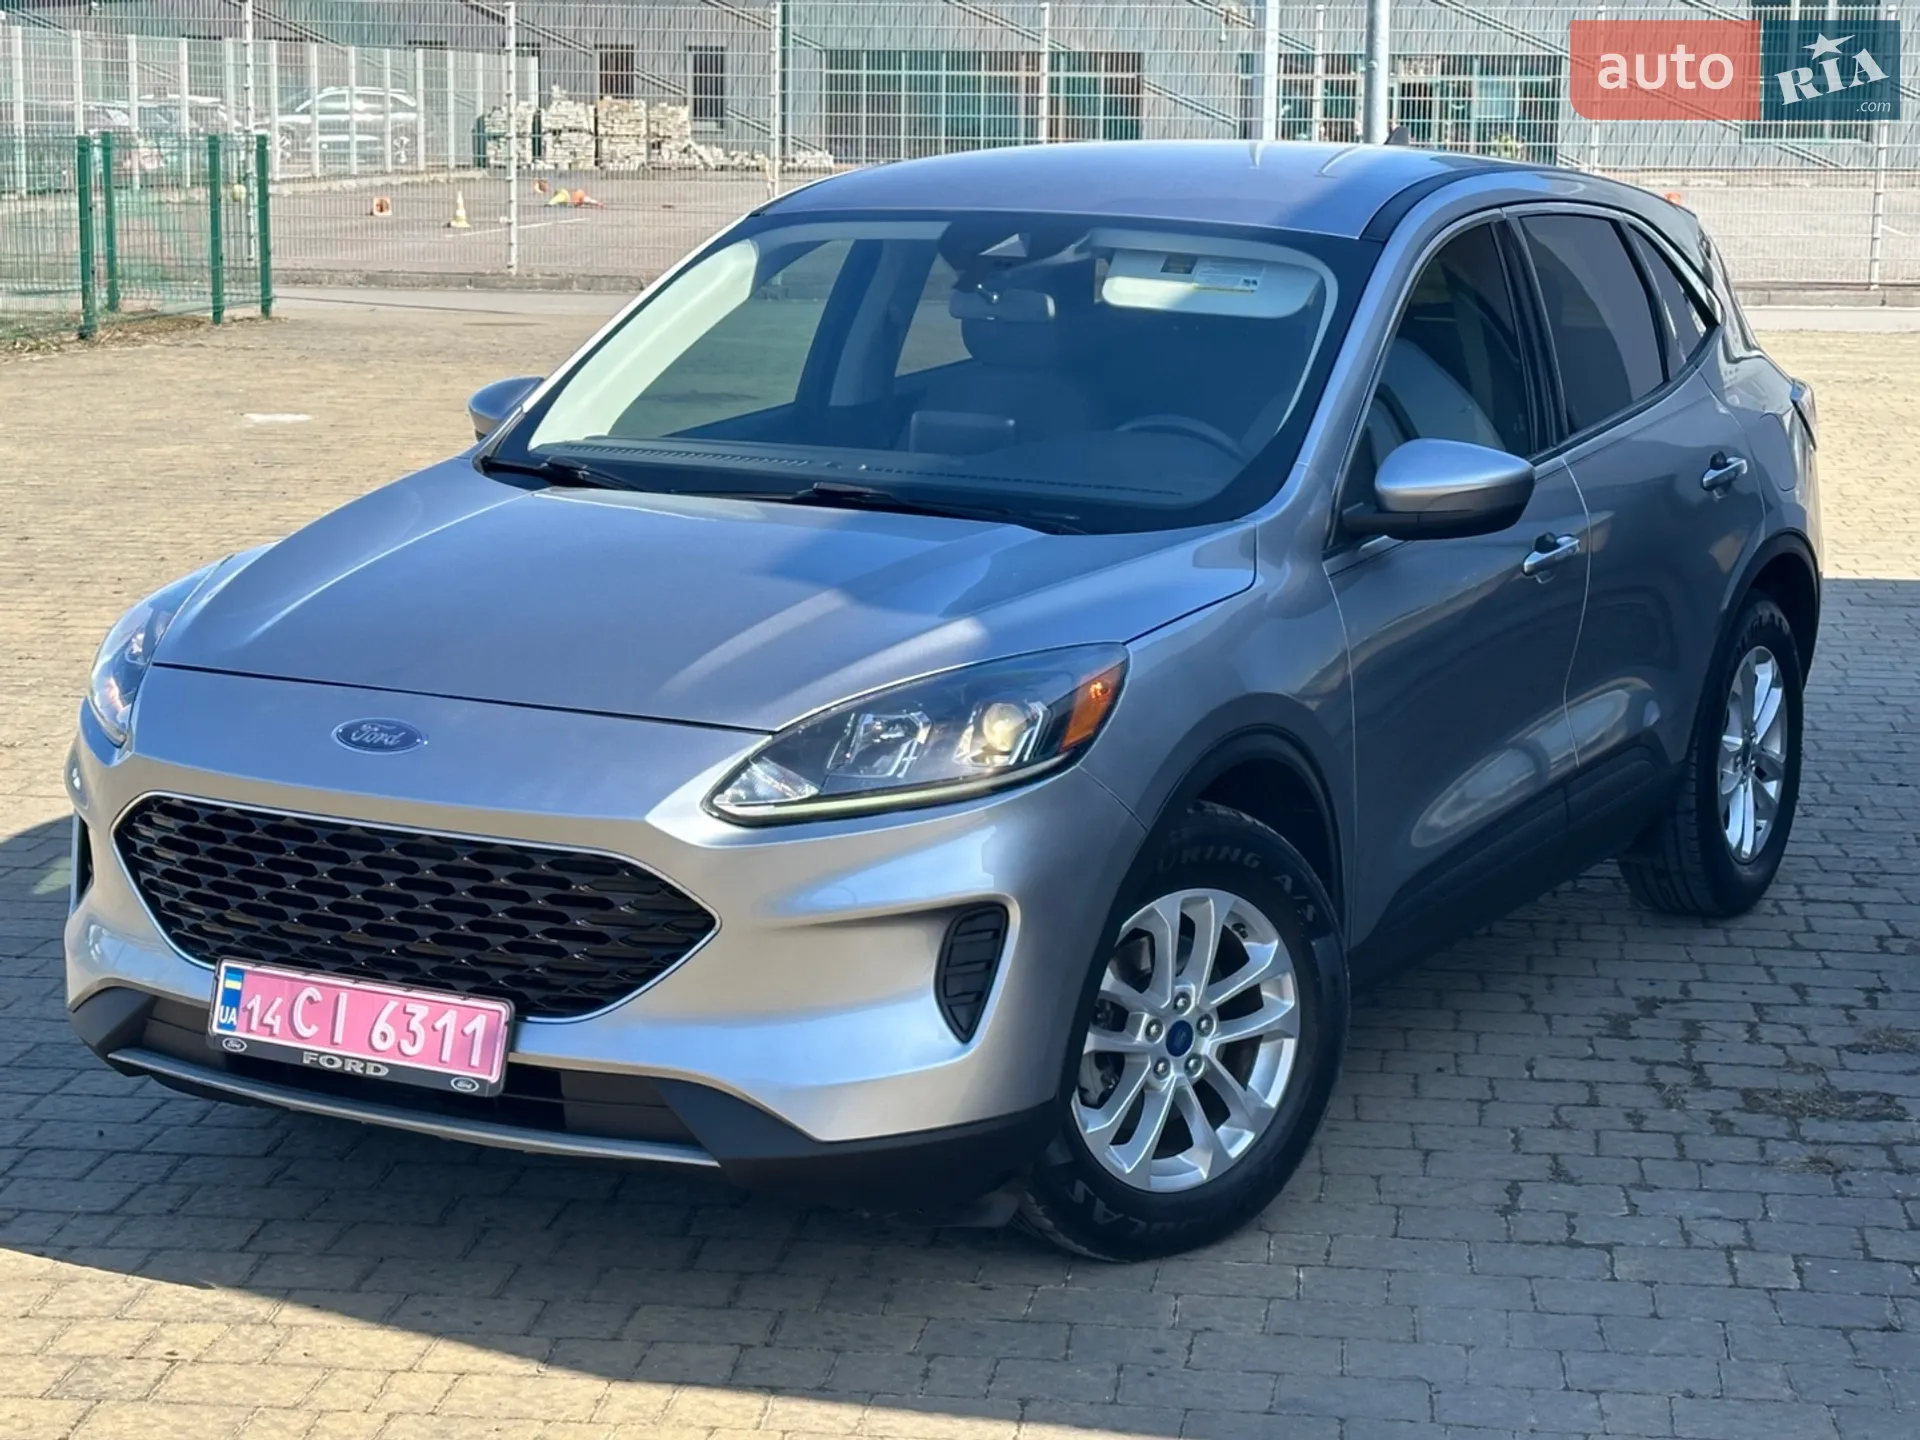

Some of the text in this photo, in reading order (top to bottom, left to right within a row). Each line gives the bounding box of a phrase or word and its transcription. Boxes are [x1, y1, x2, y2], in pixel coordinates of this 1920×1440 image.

[351, 723, 406, 746] Ford
[219, 1006, 238, 1026] UA
[370, 1000, 487, 1068] 6311
[302, 1051, 389, 1078] FORD
